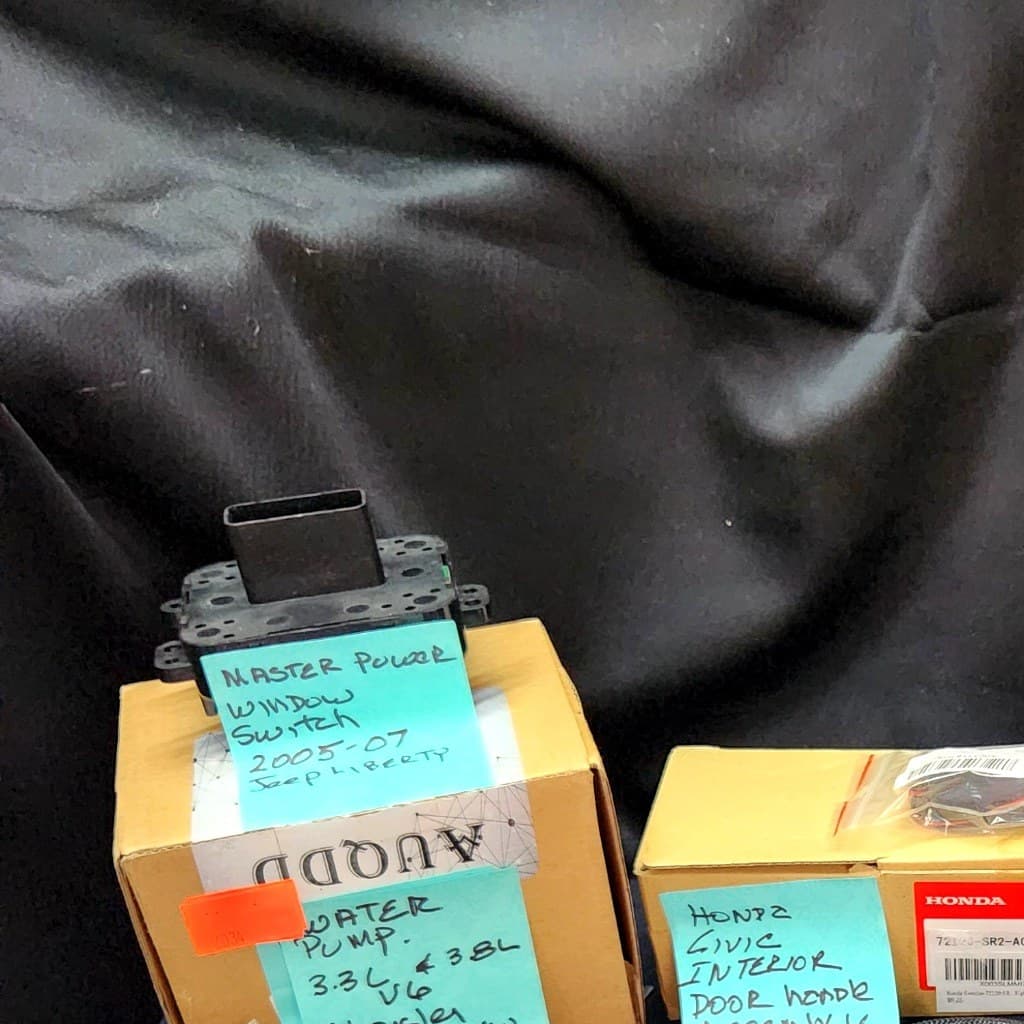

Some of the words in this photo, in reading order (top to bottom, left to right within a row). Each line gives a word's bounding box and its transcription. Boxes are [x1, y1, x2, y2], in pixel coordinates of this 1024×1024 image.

[221, 656, 344, 689] MASTER
[249, 728, 409, 774] 2005-07
[251, 822, 487, 888] AUQDD
[302, 894, 445, 936] WATER
[924, 895, 1007, 907] HONDA
[686, 928, 782, 955] CIVIC
[677, 950, 843, 988] INTERIOR
[377, 980, 434, 1008] V6
[690, 989, 775, 1020] DOOR
